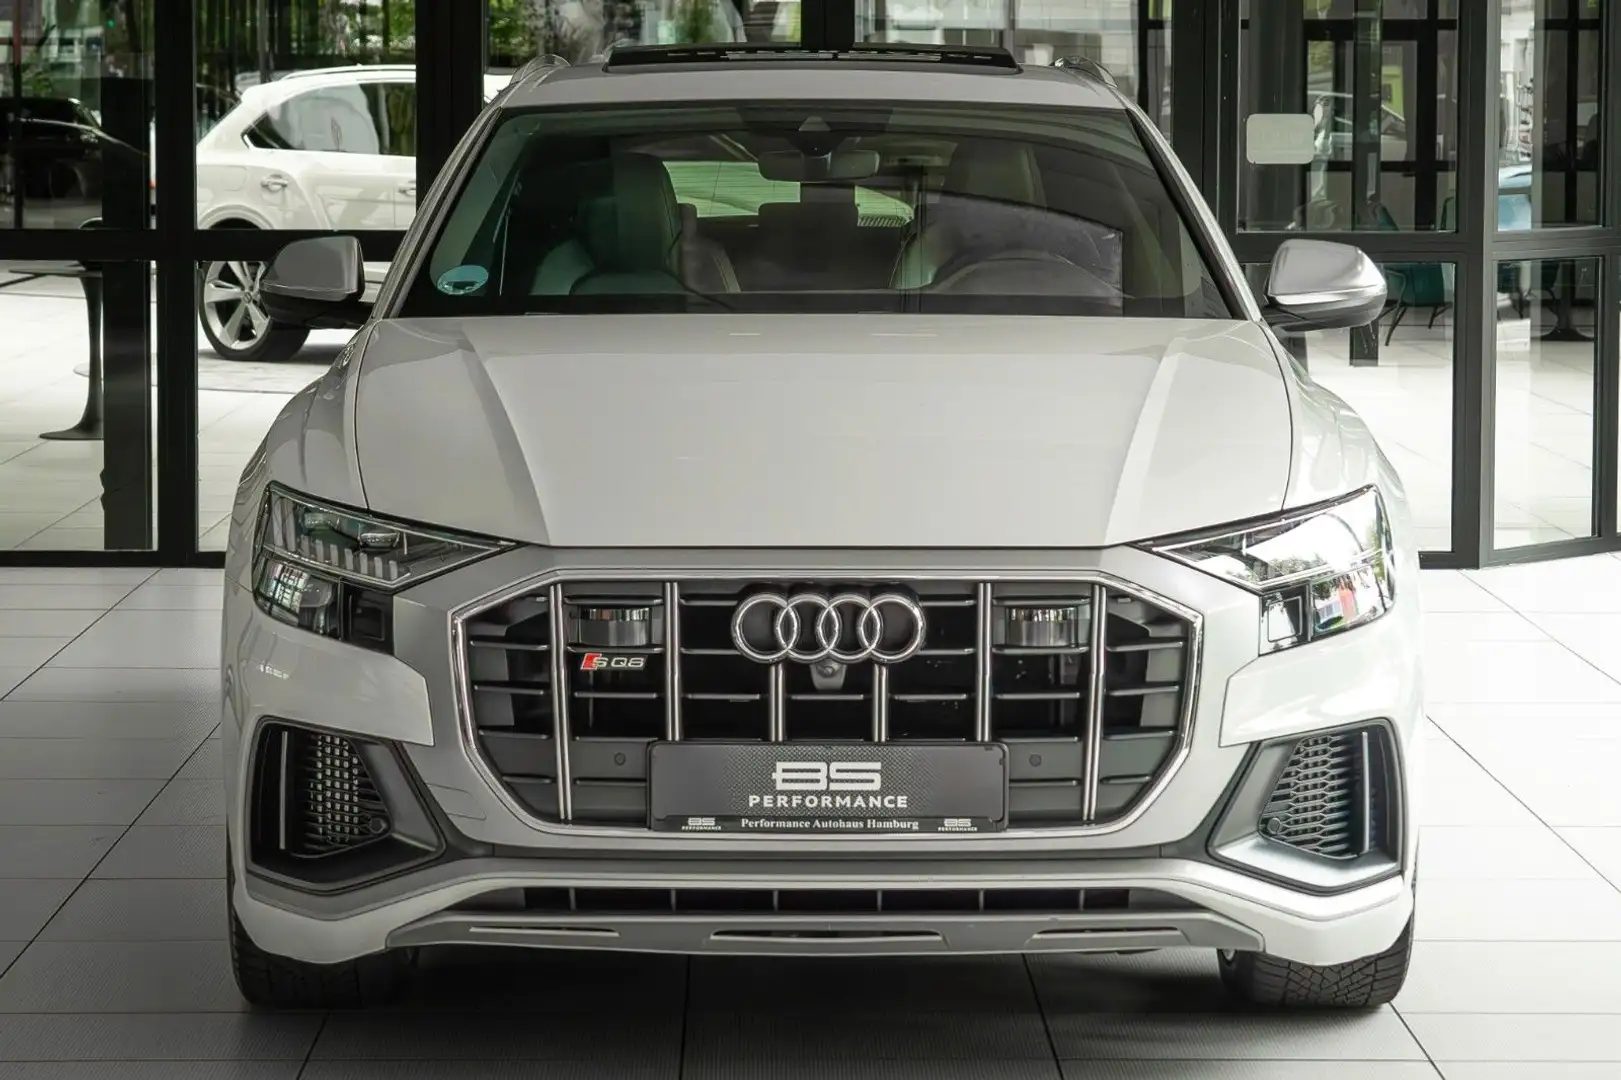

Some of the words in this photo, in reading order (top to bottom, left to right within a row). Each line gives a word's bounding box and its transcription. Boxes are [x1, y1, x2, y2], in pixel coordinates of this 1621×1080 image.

[772, 761, 882, 790] BS
[748, 795, 908, 809] PERFORMANCE
[741, 818, 811, 828] Performance
[813, 818, 865, 829] Autohaus
[867, 819, 919, 830] Hamburg
